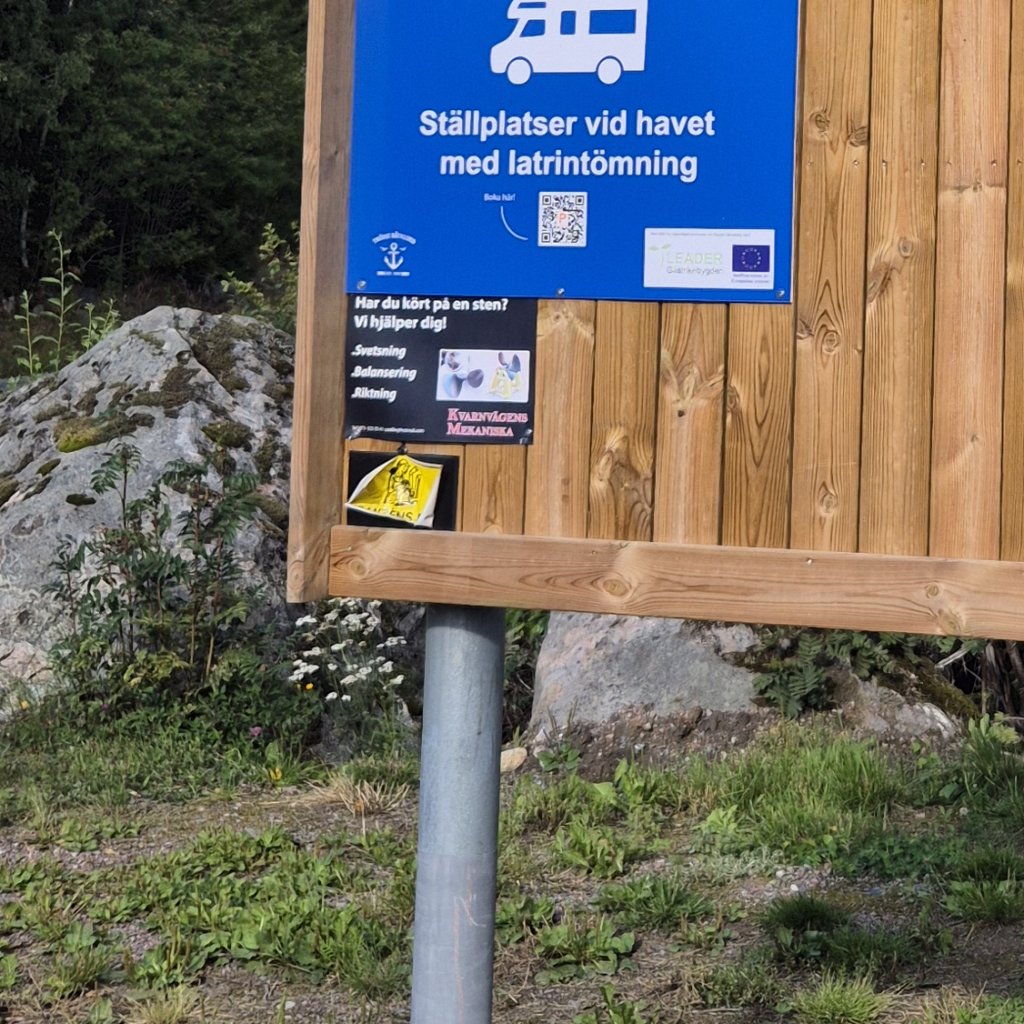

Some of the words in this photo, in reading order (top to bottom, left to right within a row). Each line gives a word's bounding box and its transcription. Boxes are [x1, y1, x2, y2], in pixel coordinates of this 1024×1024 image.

[419, 109, 577, 141] Ställplatser
[584, 109, 627, 136] vid
[636, 110, 715, 137] havet
[440, 150, 500, 176] med
[508, 150, 698, 183] latrintömning
[355, 296, 380, 309] Har
[382, 296, 399, 310] du
[402, 296, 431, 310] kört
[433, 297, 450, 313] på
[452, 300, 469, 310] en
[472, 298, 509, 311] sten?
[354, 315, 368, 328] Vi
[370, 315, 419, 332] hjälper
[420, 316, 447, 333] dig!
